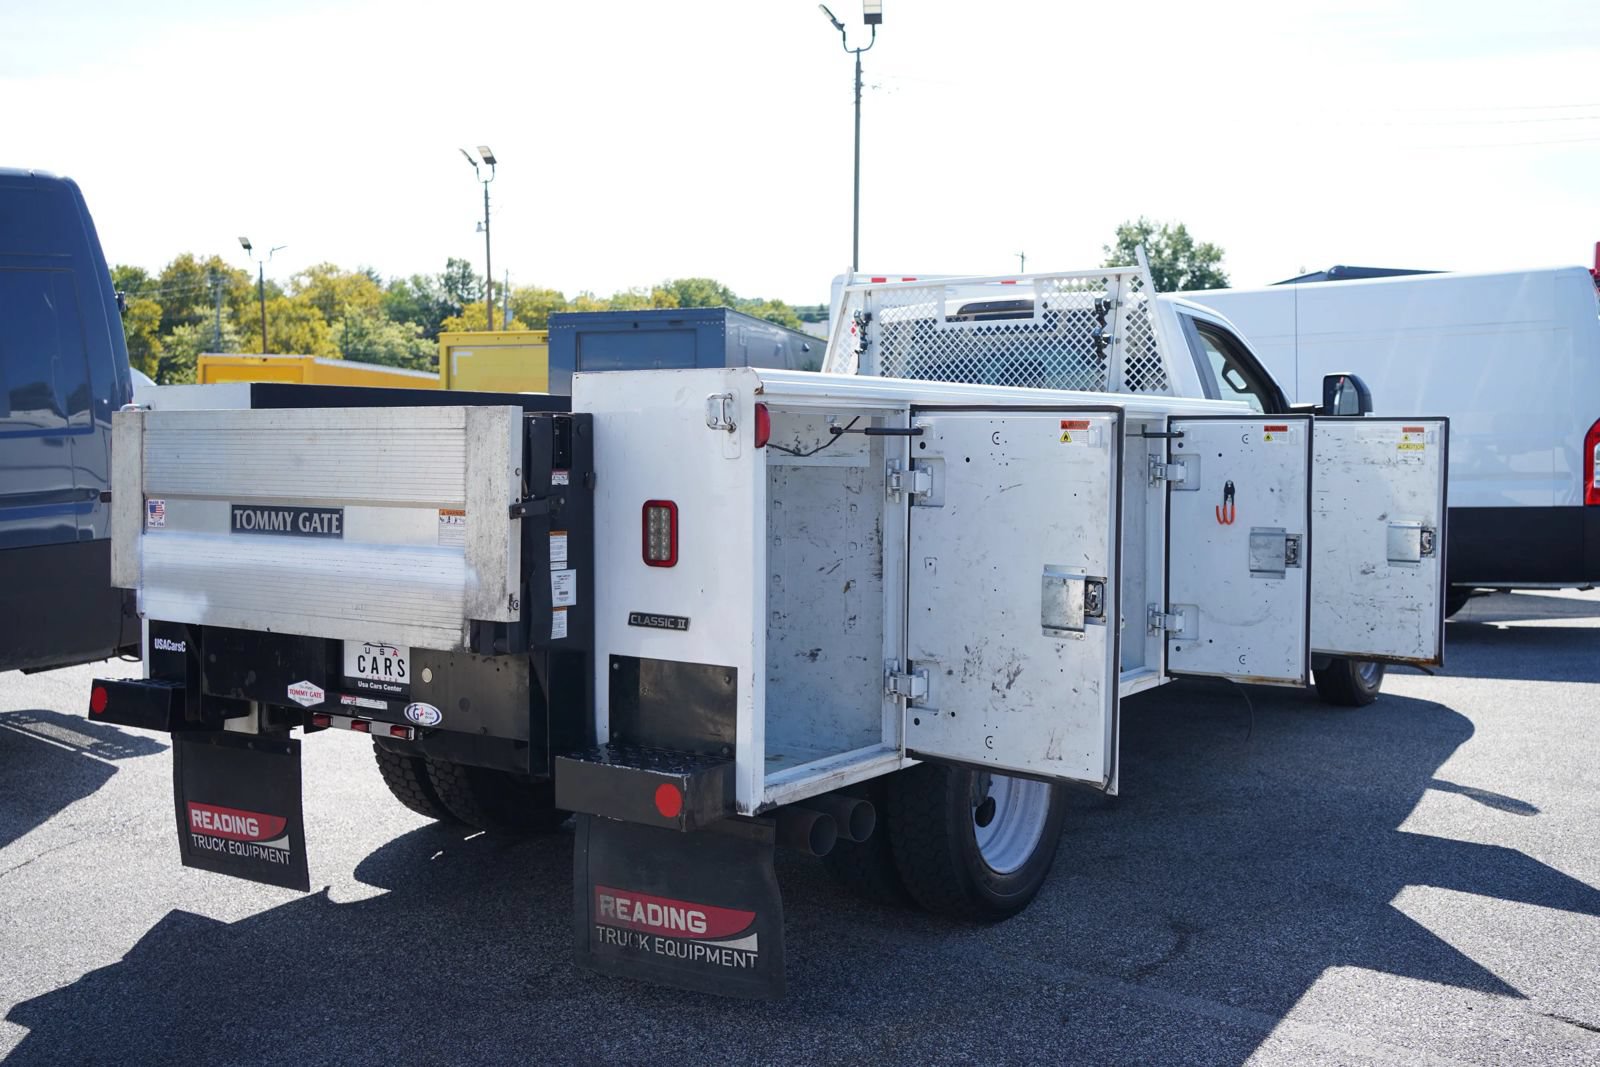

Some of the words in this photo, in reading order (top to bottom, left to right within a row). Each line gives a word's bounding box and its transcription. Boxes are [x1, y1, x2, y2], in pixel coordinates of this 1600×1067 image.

[233, 509, 294, 532] TOMMY
[298, 511, 341, 534] GATE
[630, 614, 674, 627] CLASSIC
[677, 619, 686, 629] II
[357, 654, 405, 677] CARS
[289, 688, 308, 697] TOMMY
[309, 690, 322, 699] GATE
[383, 684, 403, 692] Center
[191, 809, 259, 837] READING
[192, 834, 227, 852] TRUCK
[229, 841, 291, 865] EQUIPMENT
[599, 894, 707, 934] READING
[596, 926, 649, 951] TRUCK
[655, 938, 759, 968] EQUIPMENT
